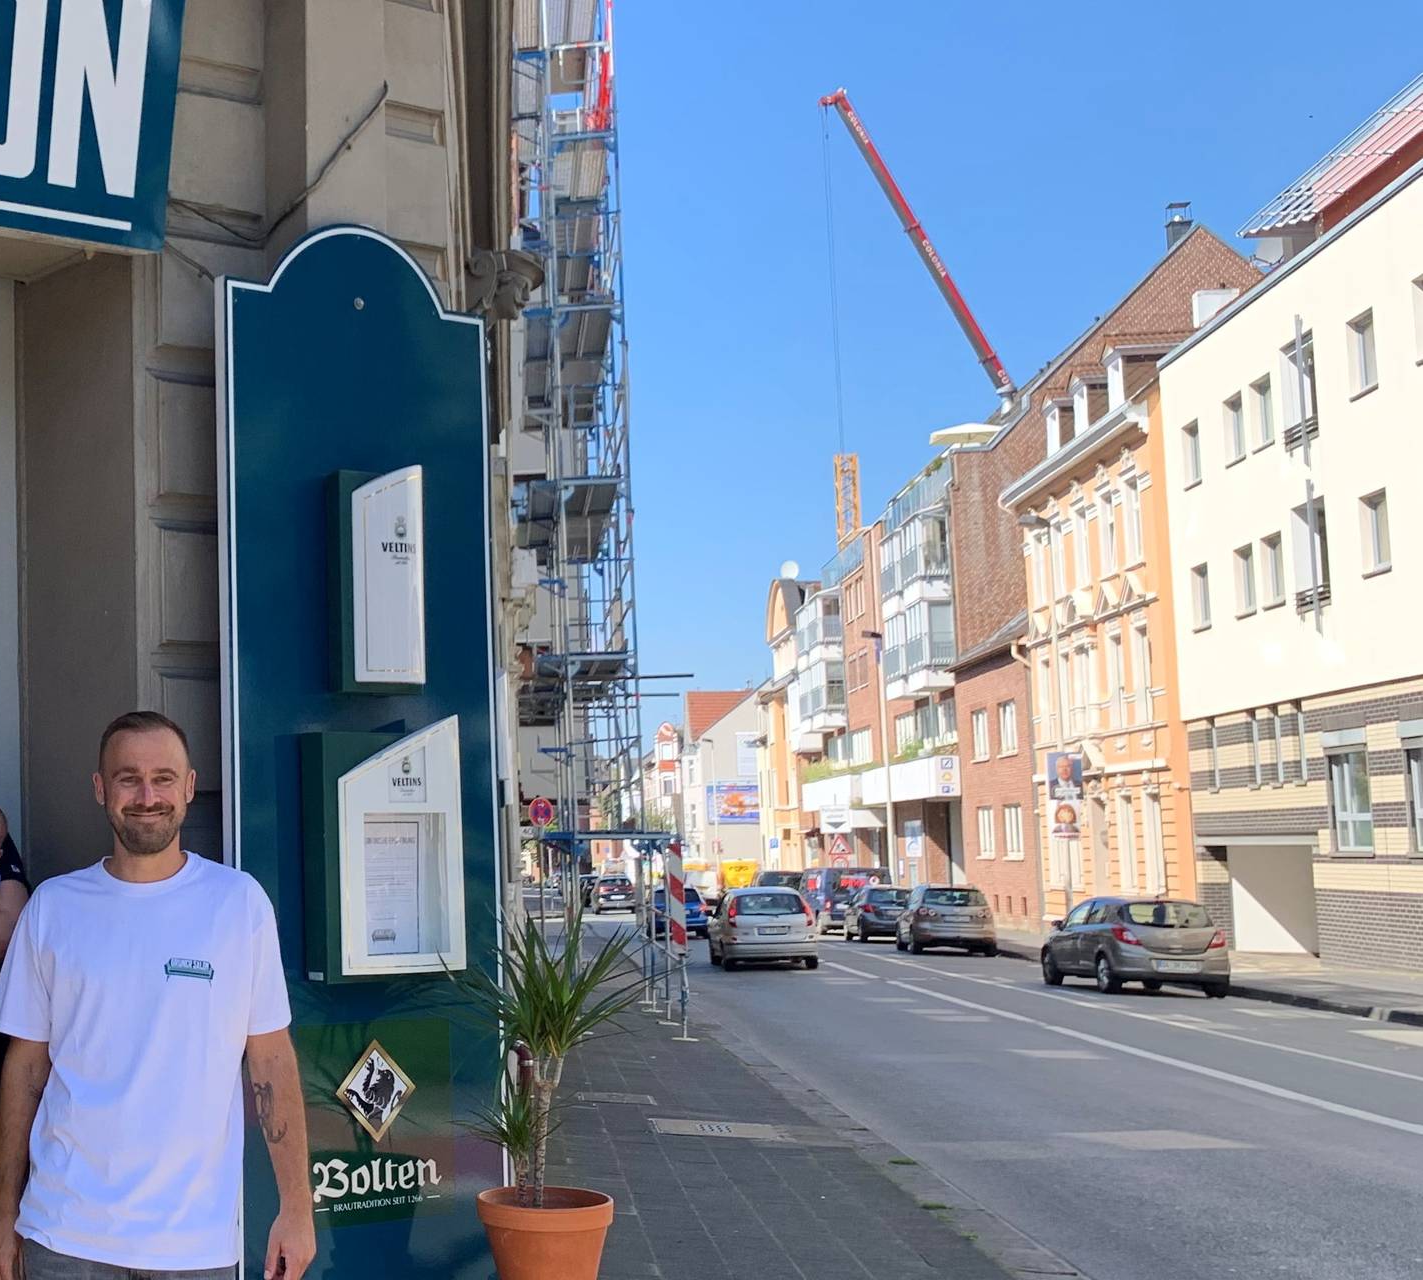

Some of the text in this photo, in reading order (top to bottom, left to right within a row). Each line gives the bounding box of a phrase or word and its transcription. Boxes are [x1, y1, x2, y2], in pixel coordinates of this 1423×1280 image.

[922, 239, 947, 278] COLONIA
[381, 541, 416, 554] VELTINS
[392, 777, 422, 787] VELTINS
[313, 1157, 442, 1203] Bolten
[333, 1197, 392, 1213] BRAUTRADITION
[392, 1195, 406, 1206] SEIT
